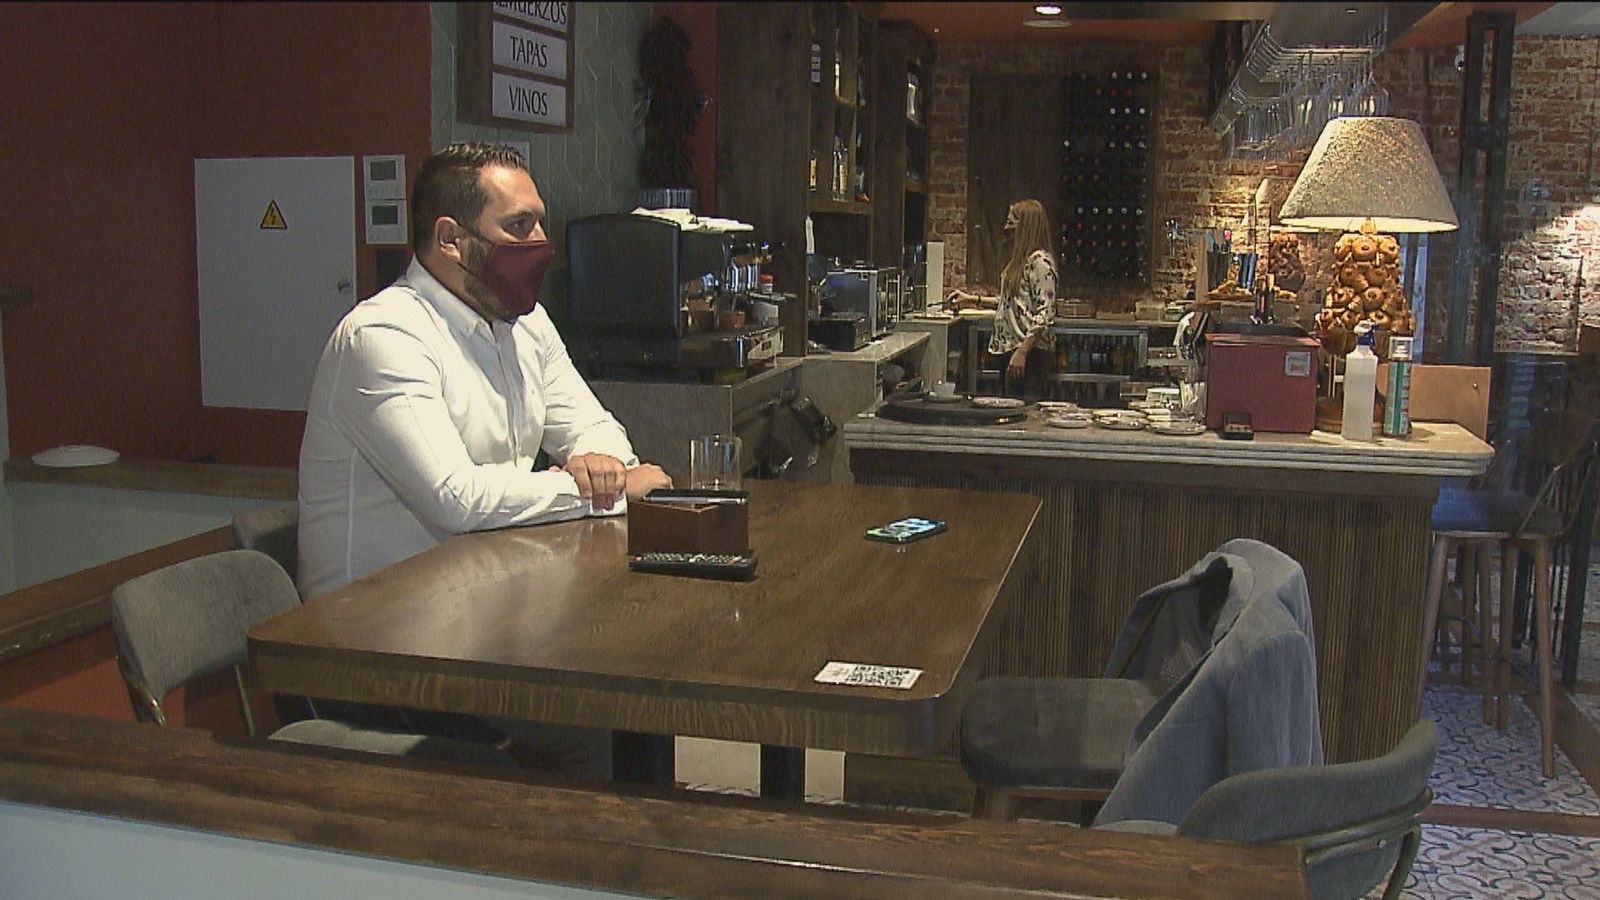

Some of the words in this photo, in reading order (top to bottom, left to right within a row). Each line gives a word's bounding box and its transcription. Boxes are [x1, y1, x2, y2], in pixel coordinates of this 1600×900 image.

[495, 1, 566, 25] UERZOS
[510, 35, 547, 68] TAPAS
[508, 85, 548, 116] VINOS
